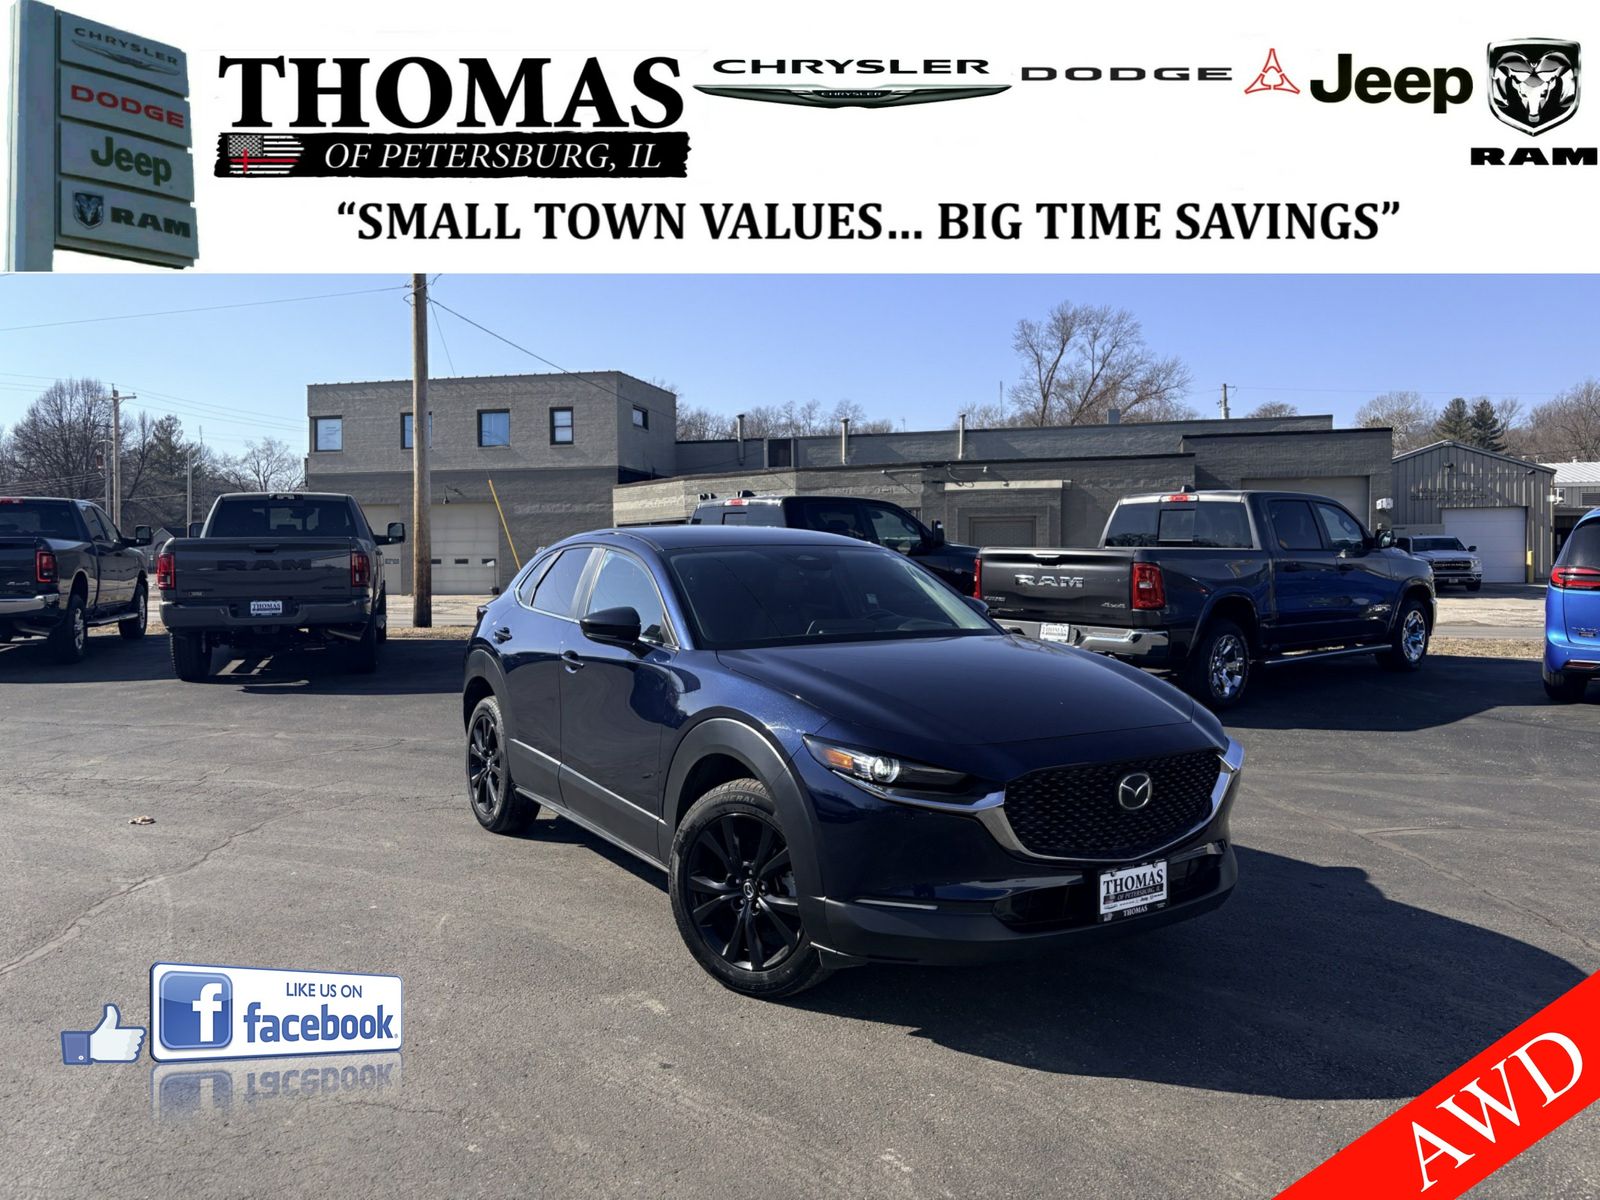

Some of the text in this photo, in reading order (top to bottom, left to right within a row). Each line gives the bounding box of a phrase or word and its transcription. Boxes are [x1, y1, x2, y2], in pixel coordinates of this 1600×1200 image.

[216, 559, 312, 571] RAM
[1014, 574, 1084, 588] RAM
[1103, 869, 1164, 894] THOMAS
[1123, 904, 1148, 917] THOMAS
